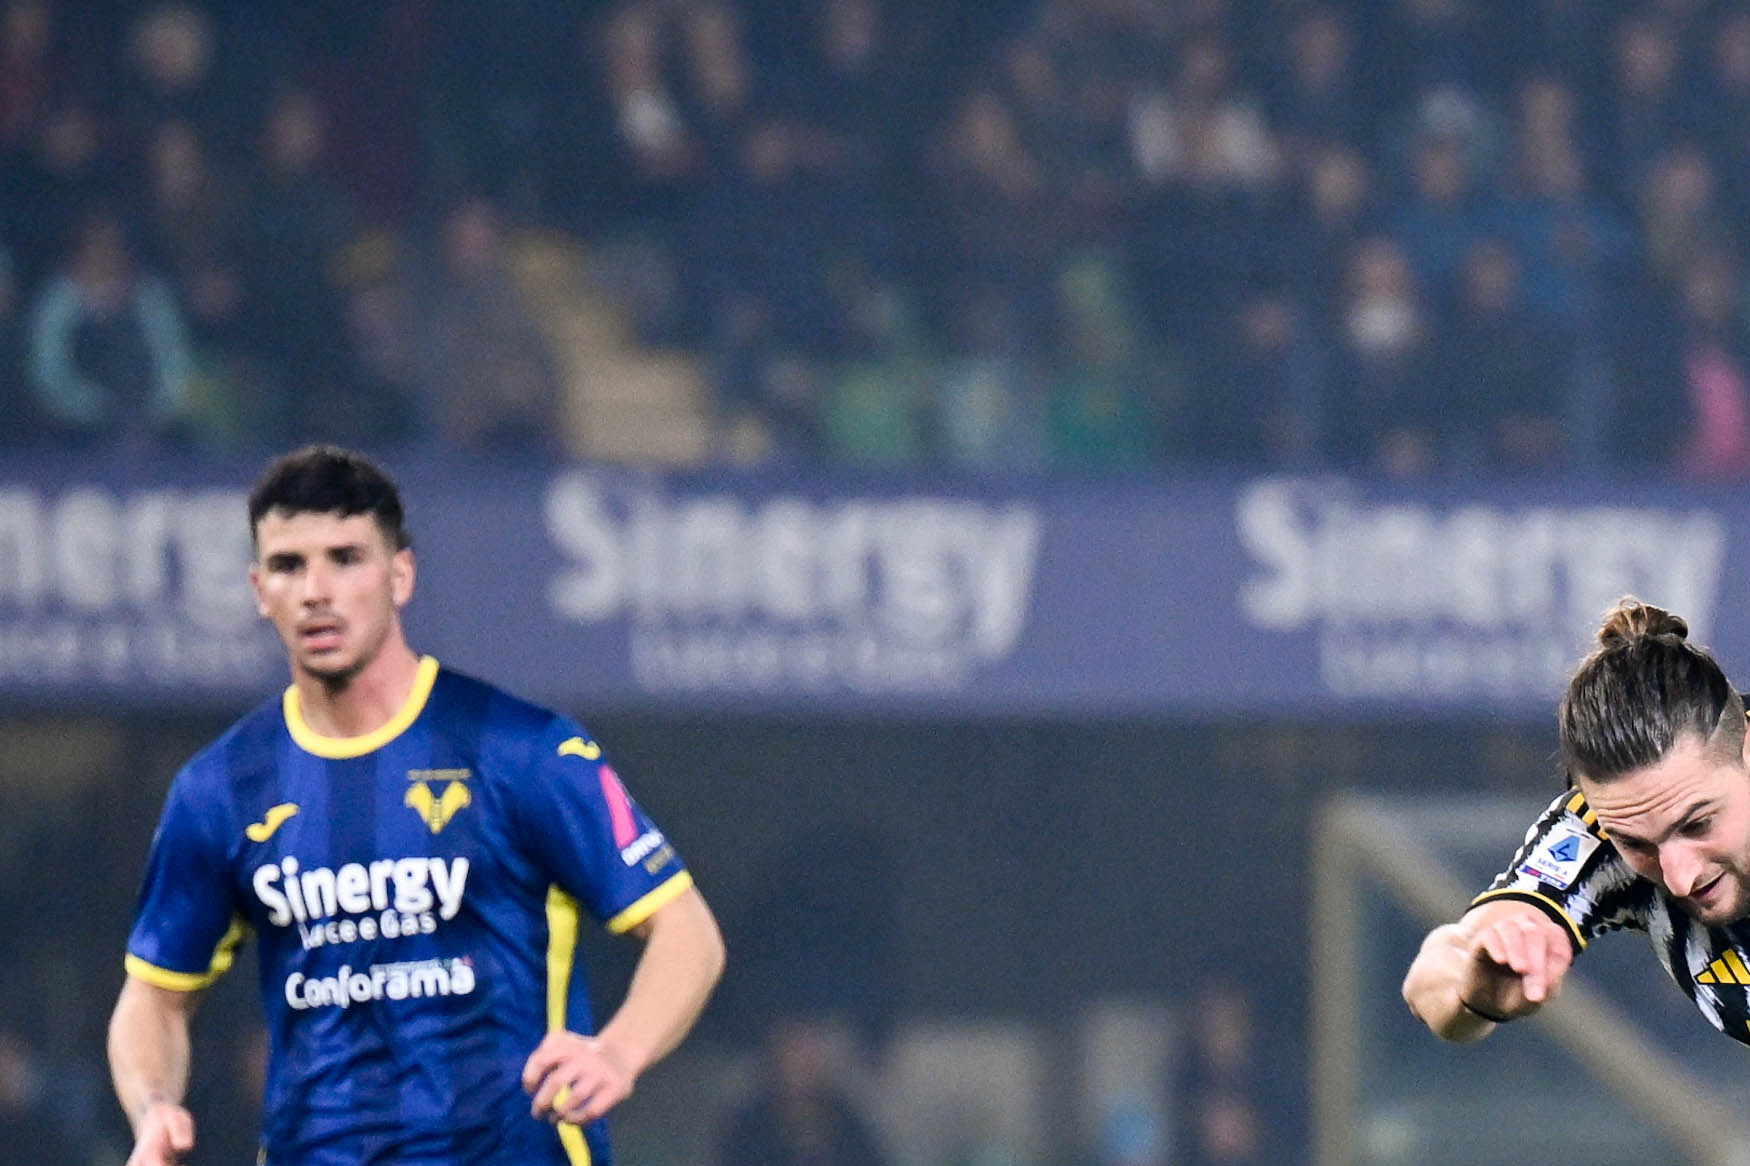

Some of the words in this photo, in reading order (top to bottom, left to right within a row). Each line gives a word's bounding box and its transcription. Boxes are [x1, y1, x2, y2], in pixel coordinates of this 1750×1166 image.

[547, 470, 1041, 659] Sinergy
[1237, 476, 1724, 652] Sinergy
[253, 855, 470, 927] Sinergy
[285, 959, 476, 1011] Conforama
